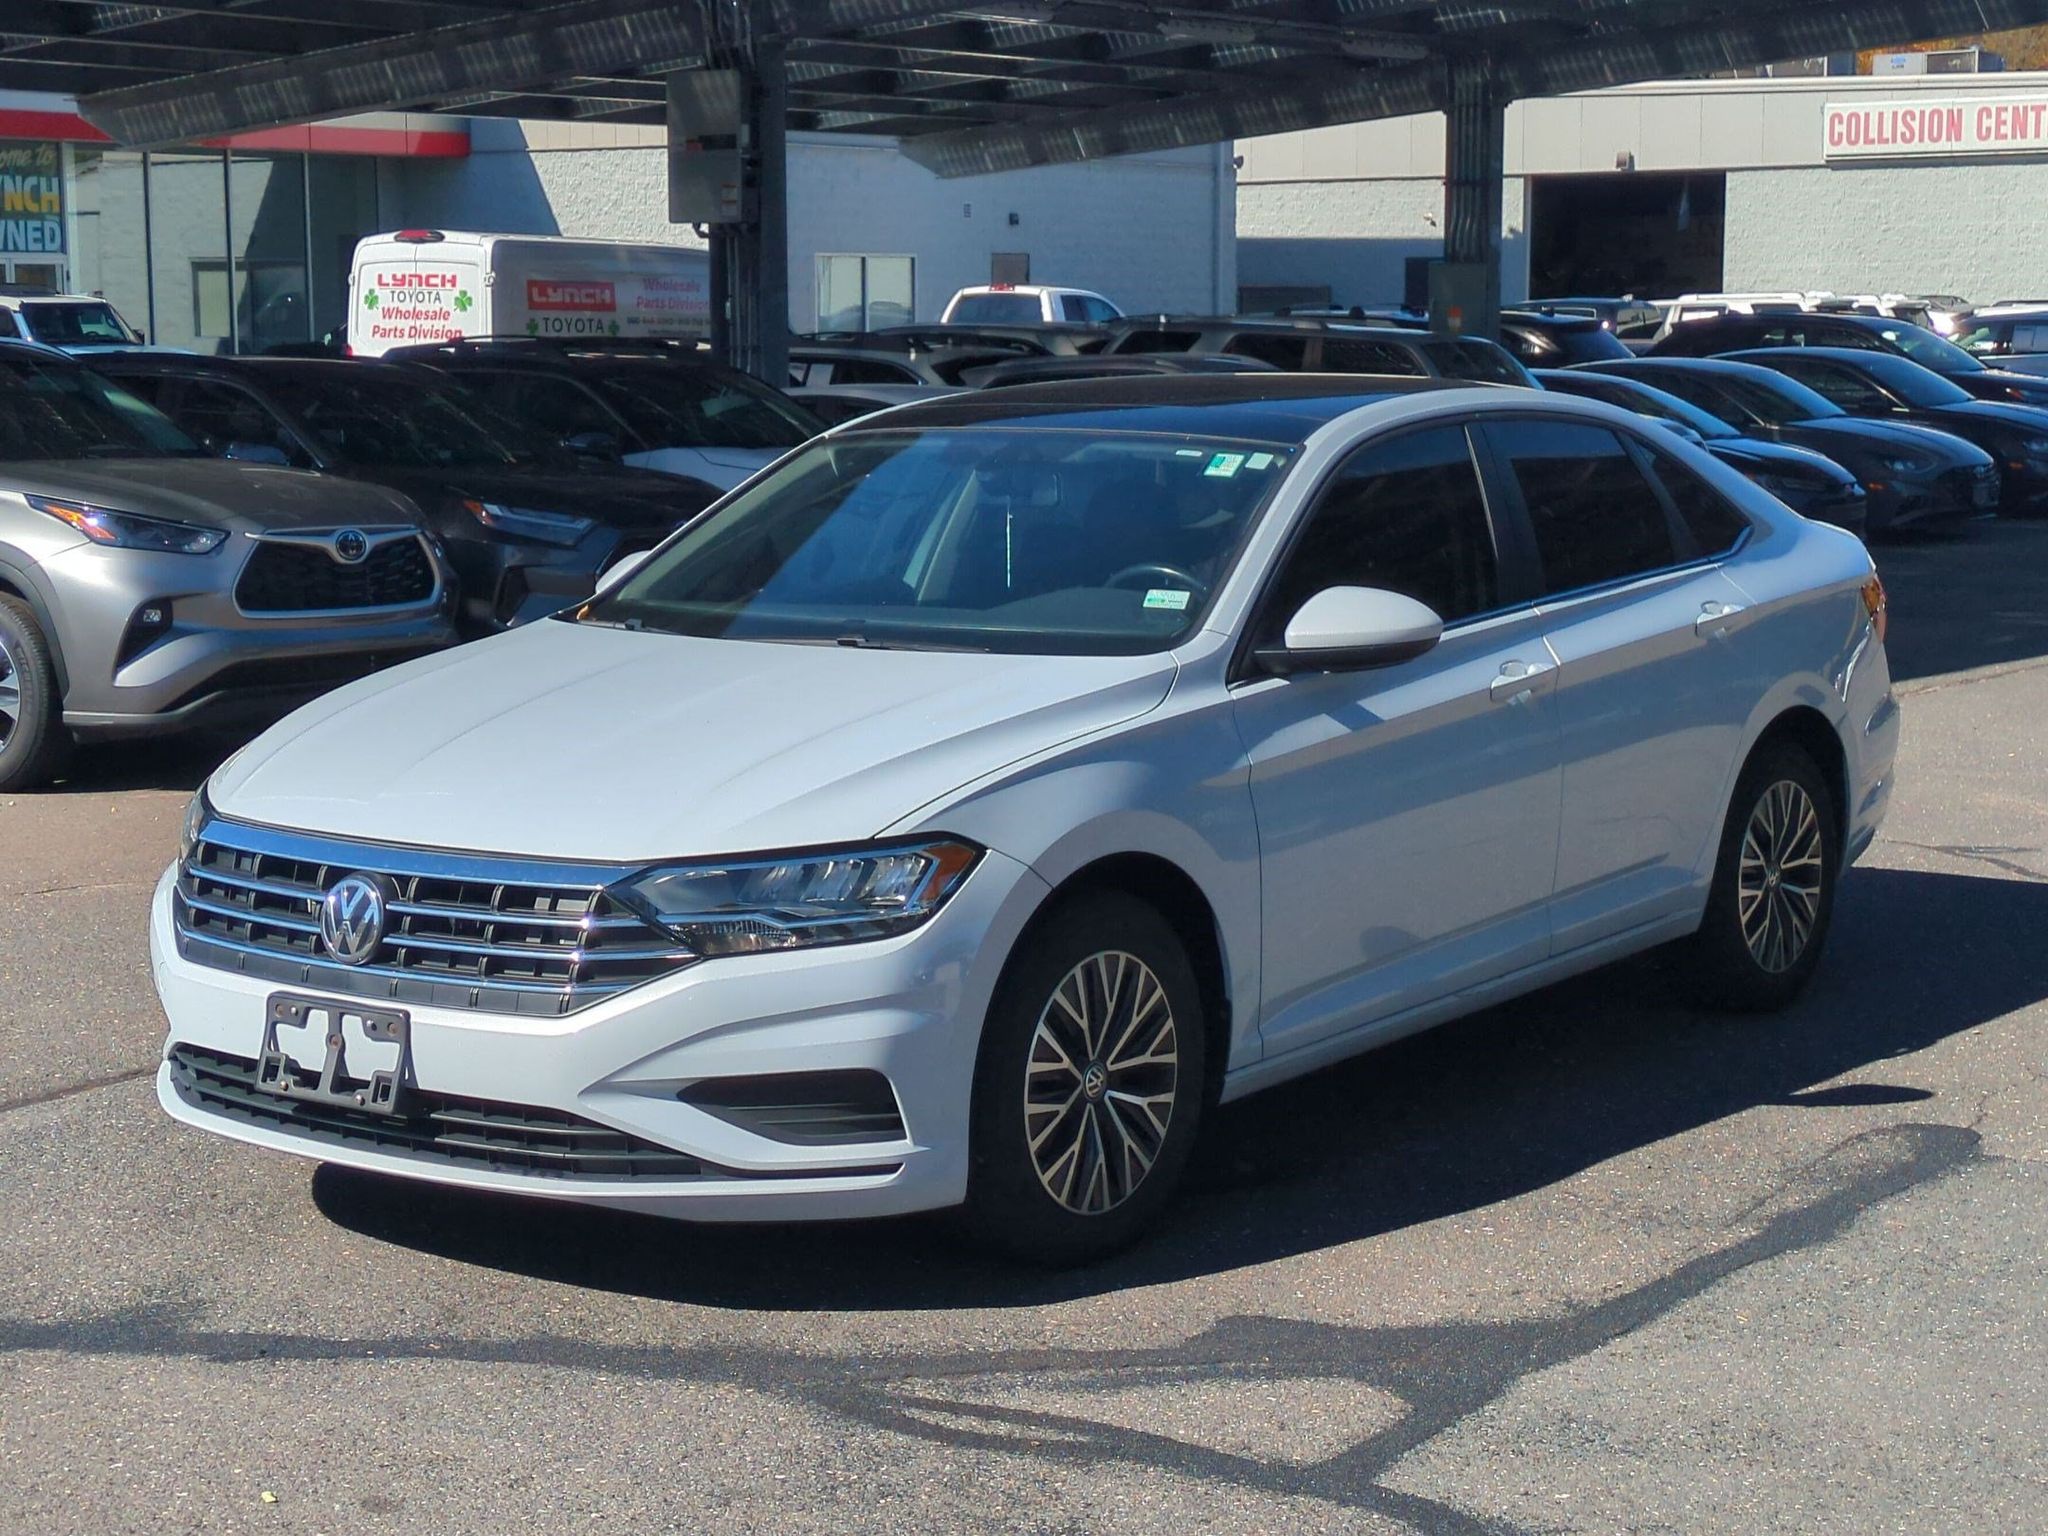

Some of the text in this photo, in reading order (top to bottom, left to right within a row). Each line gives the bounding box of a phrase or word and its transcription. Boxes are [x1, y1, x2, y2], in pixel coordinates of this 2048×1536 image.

[1828, 104, 2048, 147] COLLISION CENT
[0, 174, 61, 213] NCH
[390, 290, 442, 304] TOYOTA
[381, 306, 451, 321] Wholesale
[371, 323, 463, 340] Parts Division
[542, 317, 605, 334] TOYOTA
